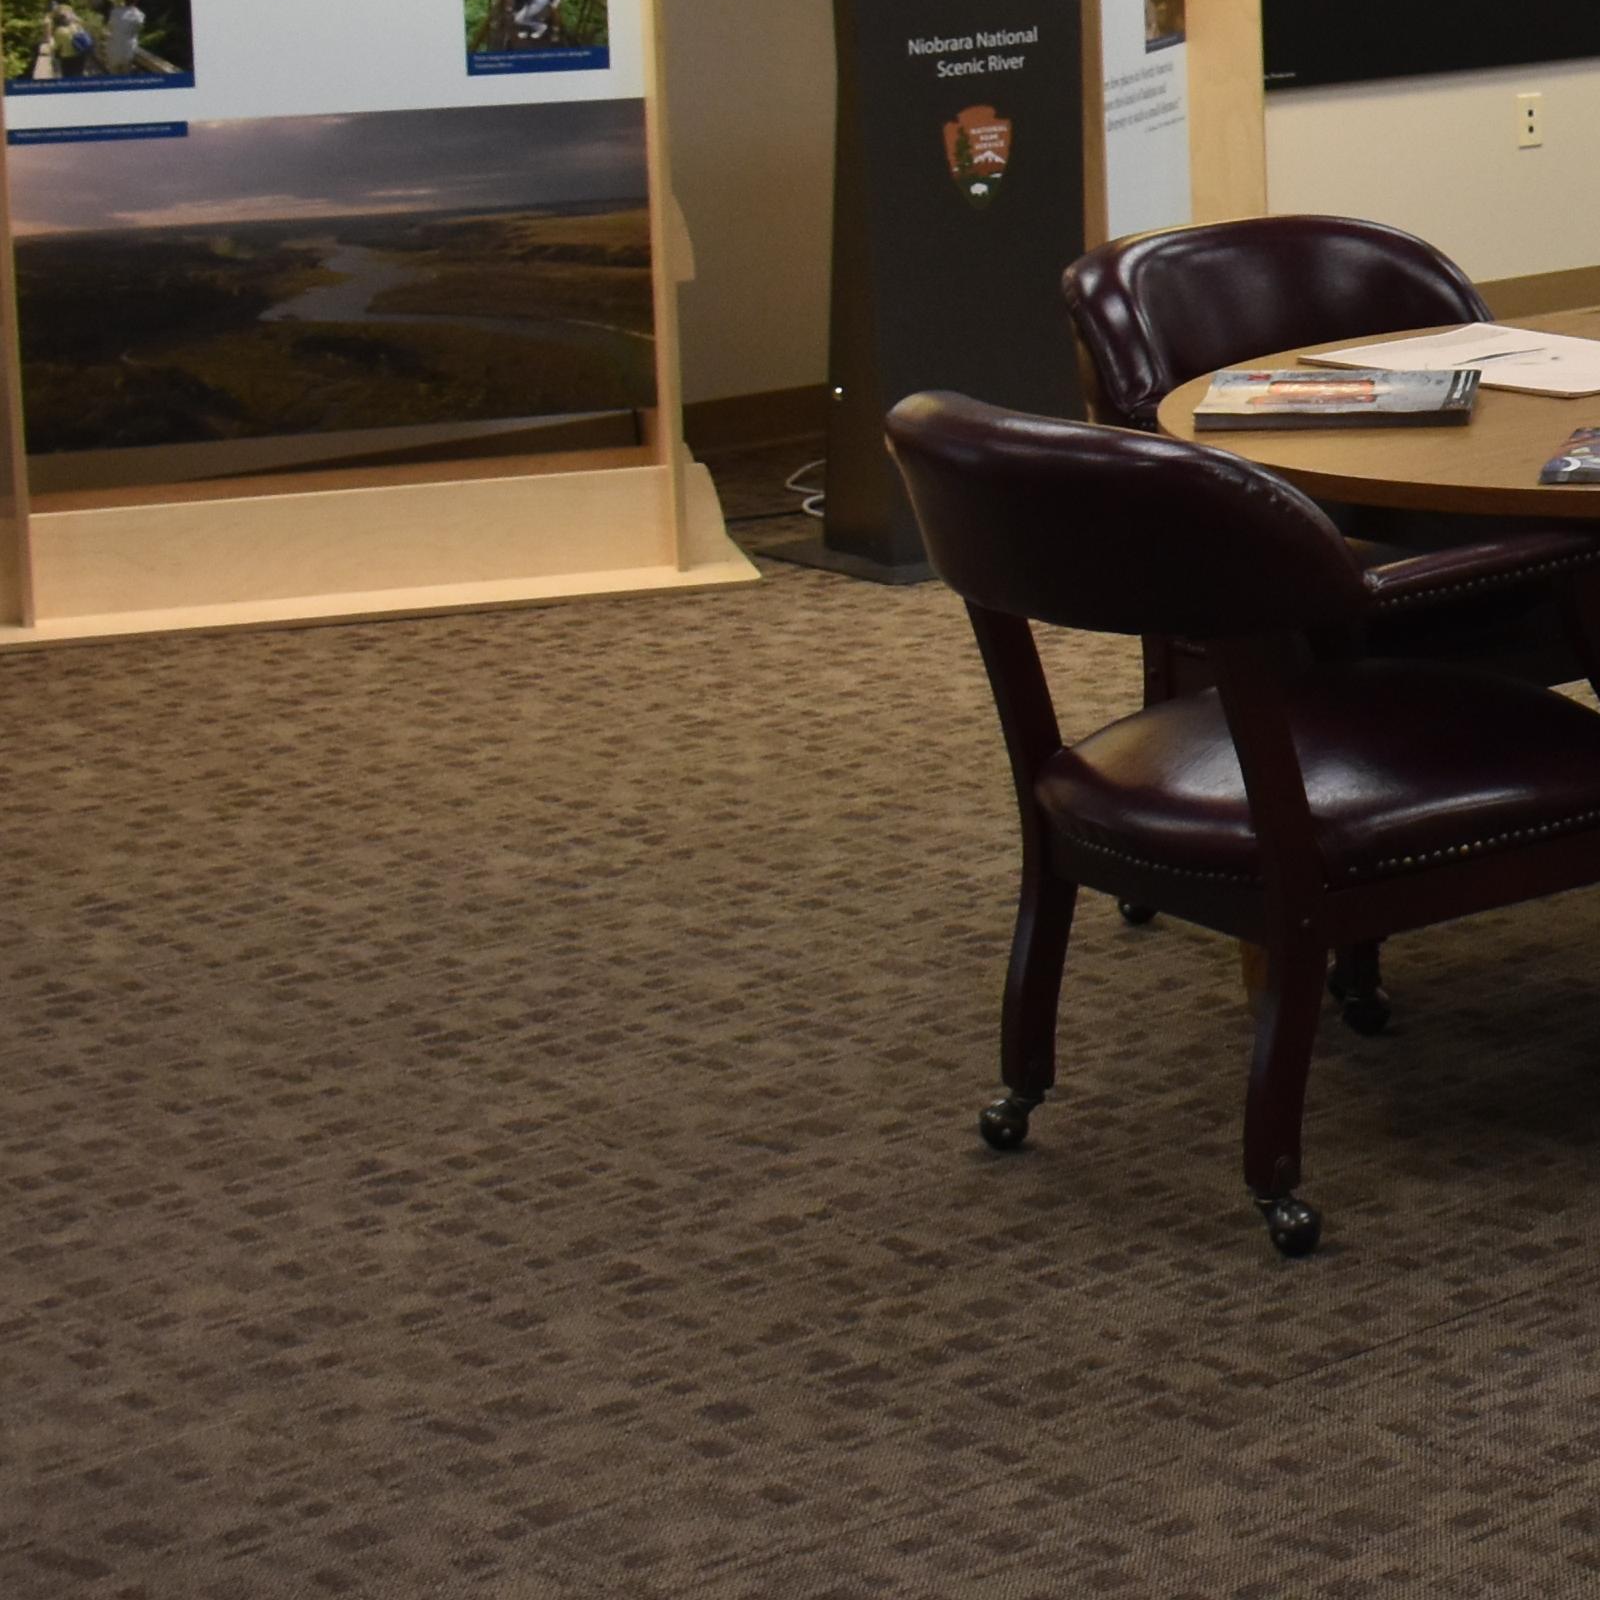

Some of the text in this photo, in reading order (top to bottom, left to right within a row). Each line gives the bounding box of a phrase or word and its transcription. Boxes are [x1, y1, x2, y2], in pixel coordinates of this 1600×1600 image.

[908, 25, 1038, 56] Niobrara National
[937, 54, 1026, 78] Scenic River
